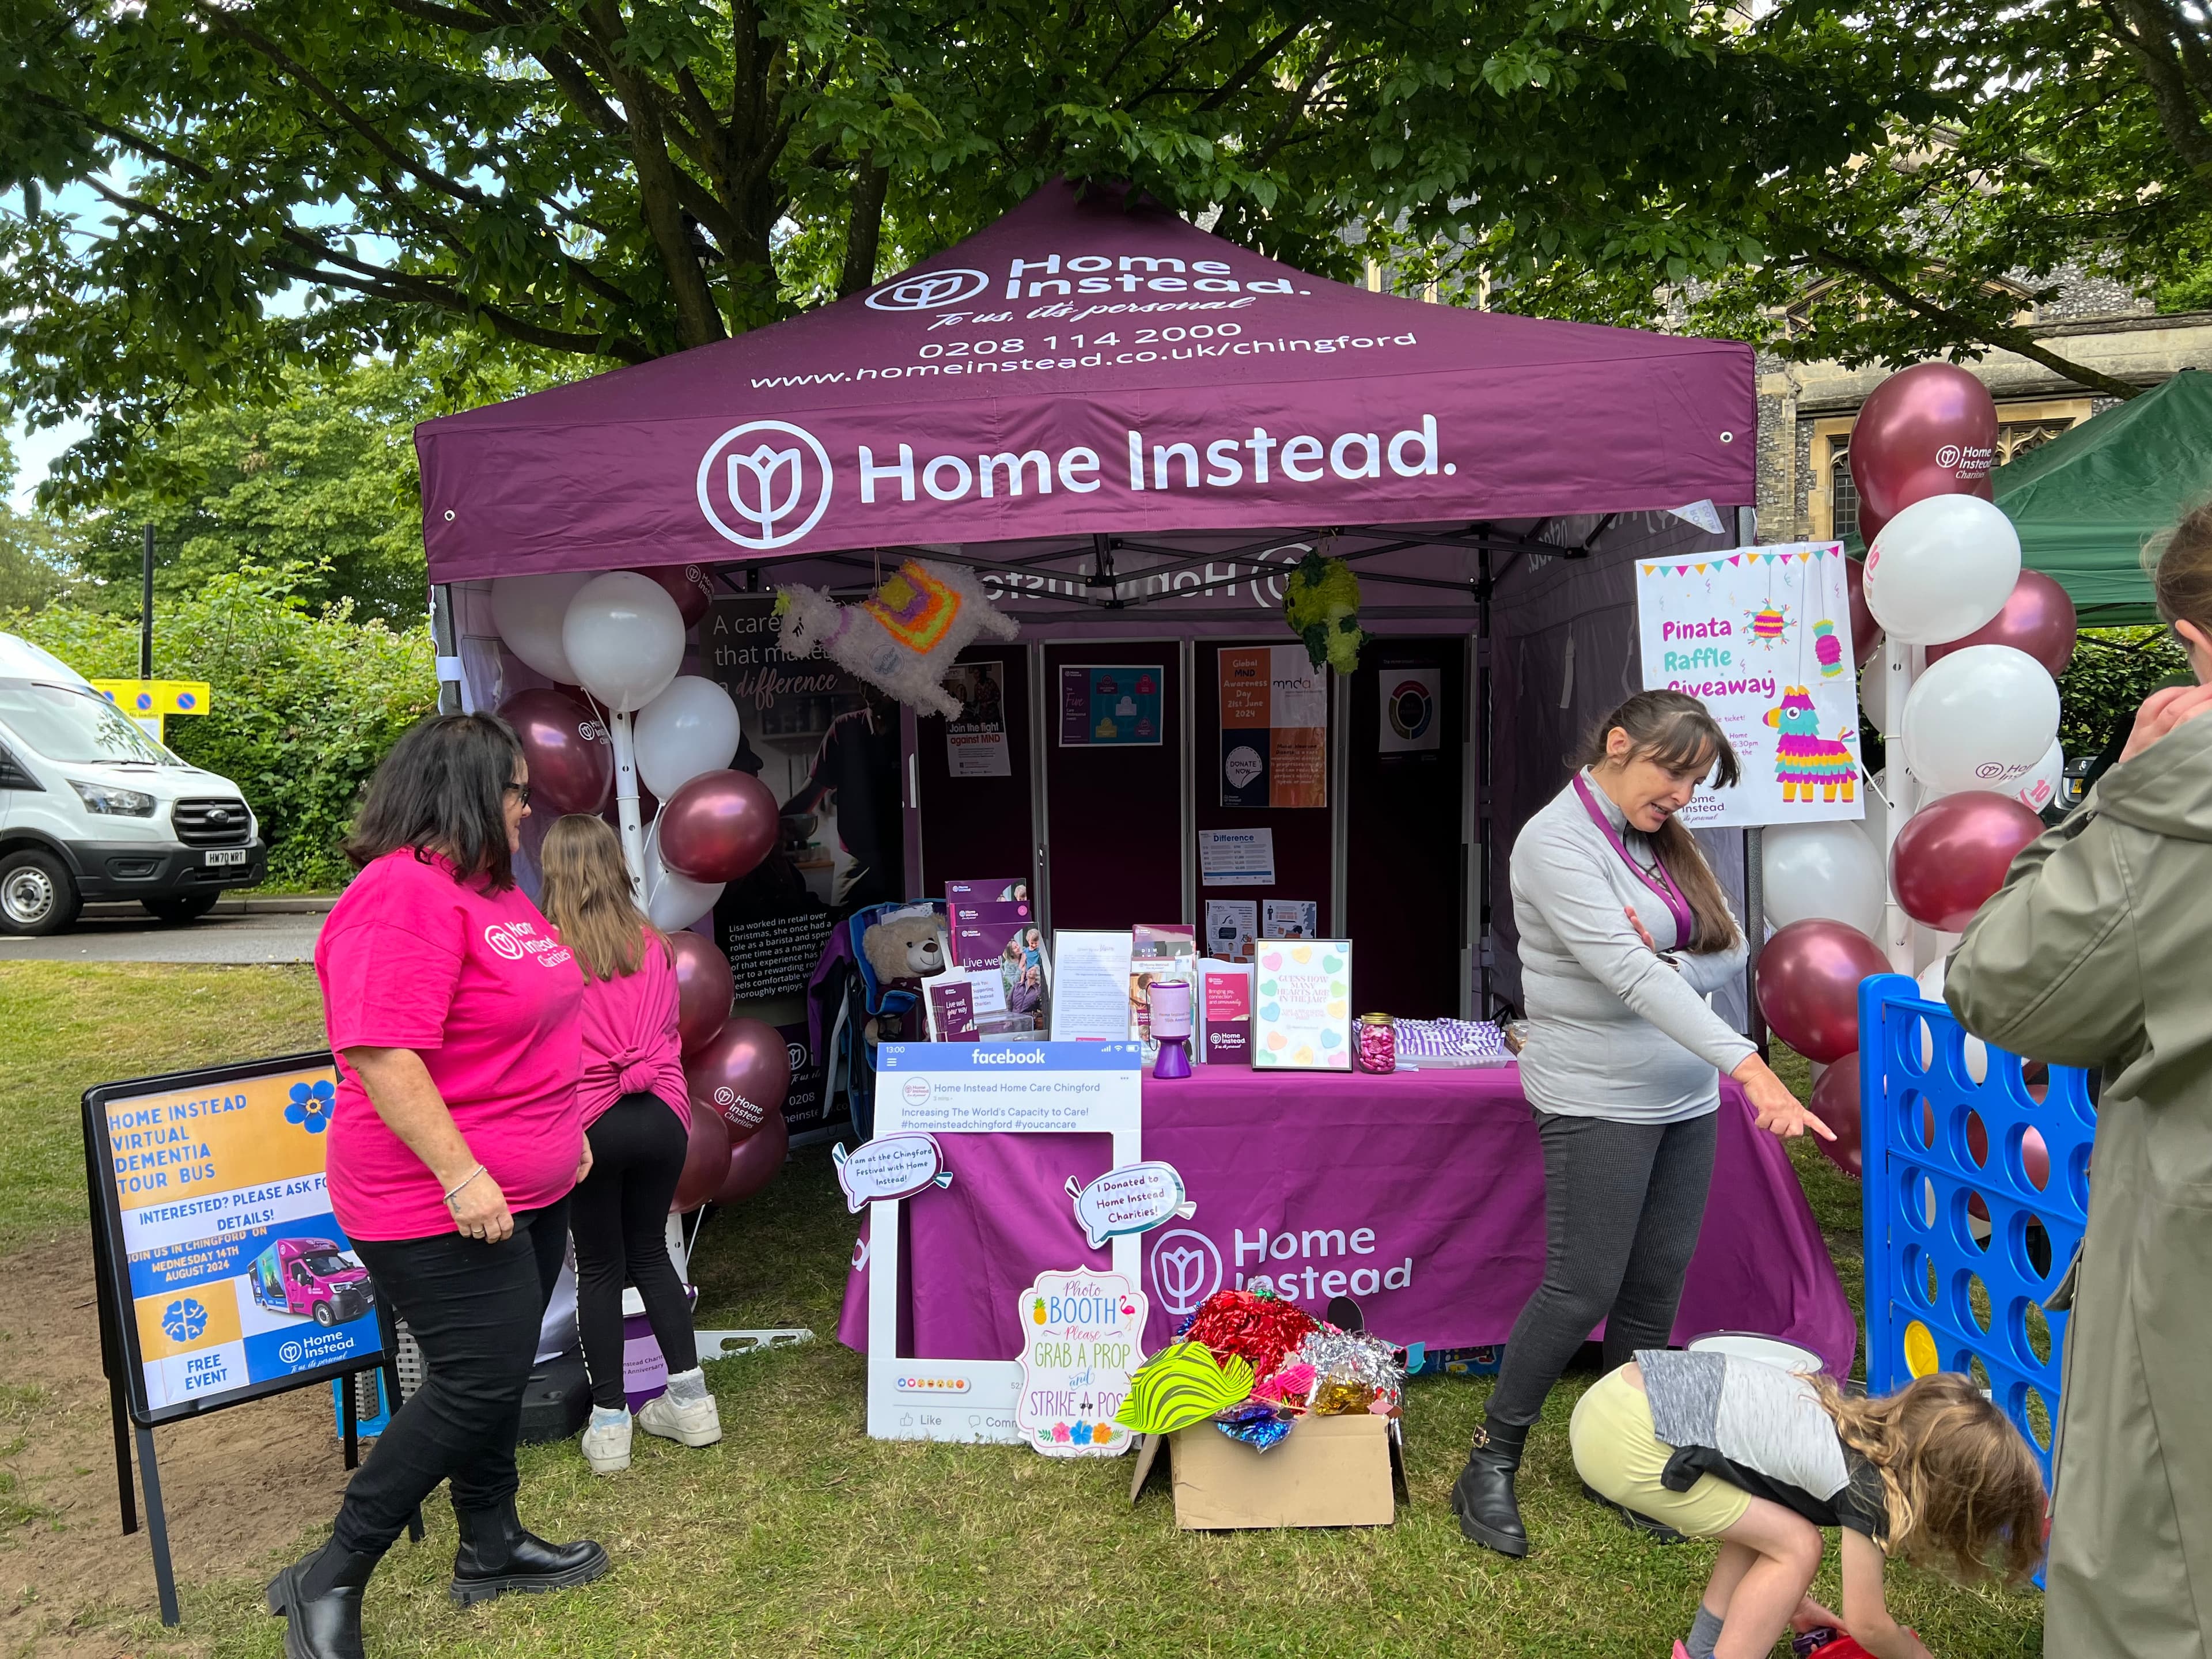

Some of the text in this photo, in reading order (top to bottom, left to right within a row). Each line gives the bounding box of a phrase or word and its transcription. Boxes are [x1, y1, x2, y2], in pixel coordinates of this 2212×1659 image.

[1009, 254, 1230, 278] Home
[1006, 272, 1311, 300] Instead.
[927, 312, 968, 331] To
[973, 308, 1013, 323] us,
[1070, 297, 1256, 323] personal
[919, 323, 1241, 357] 0208 114 2000
[749, 332, 1416, 388] www.homeinstead.co.uk/chingford
[858, 414, 1457, 503] Home Instead.
[1963, 446, 1991, 457] Home
[1959, 457, 1993, 469] Instead
[1956, 470, 1986, 479] Charities
[713, 615, 728, 635] A
[1663, 618, 1732, 642] Pinata
[714, 645, 759, 666] that
[1233, 659, 1257, 668] Global
[1664, 647, 1732, 672] Raffle
[1234, 669, 1255, 677] MND
[736, 666, 838, 710] difference
[1273, 677, 1310, 689] mnda
[1236, 690, 1251, 699] Day
[1228, 700, 1243, 708] 21st
[1235, 710, 1255, 718] 2024
[950, 722, 999, 733] Join the fight
[950, 734, 1000, 747] against MND
[1691, 813, 1718, 823] personal
[210, 853, 229, 863] HW70
[747, 919, 776, 930] worked
[788, 914, 808, 924] retail
[810, 912, 827, 921] over
[730, 931, 771, 942] Christmas,
[774, 927, 787, 935] she
[810, 921, 825, 930] had
[730, 942, 746, 952] role
[766, 935, 793, 946] barista
[795, 933, 809, 942] and
[730, 953, 752, 962] some
[754, 949, 772, 958] time
[792, 941, 818, 952] nanny.
[731, 951, 818, 971] of that experience has
[764, 963, 804, 975] rewarding
[963, 958, 982, 968] Live
[753, 972, 800, 987] comfortable
[946, 1001, 955, 1009] Live
[957, 1007, 968, 1016] way
[972, 1048, 1045, 1064] facebook
[934, 1082, 1100, 1094] Home Instead Home Care Chingford
[735, 1095, 763, 1114] Home
[789, 1092, 815, 1106] 0208
[109, 1095, 247, 1130] HOME INSTEAD
[724, 1112, 753, 1128] Charities
[729, 1103, 764, 1124] Instead
[902, 1107, 1089, 1118] Increasing The World's Capacity to Care!
[901, 1120, 1076, 1130] #homeinsteadchingford #youcancare
[112, 1126, 190, 1152] VIRTUAL
[115, 1143, 211, 1173] DEMENTIA
[878, 1153, 891, 1161] the
[893, 1148, 933, 1161] Chingford
[856, 1160, 929, 1177] Festival with Home
[118, 1164, 215, 1194] TOUR BUS
[876, 1174, 908, 1186] Instead!
[1104, 1175, 1159, 1191] Donated to
[139, 1181, 312, 1225] INTERESTED? PLEASE ASK
[1096, 1188, 1165, 1209] Home Instead
[218, 1210, 274, 1230] DETAILS!
[1108, 1205, 1158, 1224] Charities!
[128, 1226, 267, 1263] JOIN US IN CHINGFORD ON
[1234, 1227, 1376, 1267] Home
[152, 1245, 239, 1273] WEDNESDAY 14TH
[166, 1261, 229, 1282] AUGUST 2024
[1063, 1280, 1103, 1297] Photo
[1051, 1297, 1116, 1324] BOOTH
[304, 1331, 343, 1348] Home
[1065, 1325, 1101, 1342] Please
[187, 1354, 221, 1373] FREE
[317, 1351, 348, 1368] personal
[1035, 1342, 1130, 1369] GRAB A PROP
[627, 1363, 664, 1374] Anniversary
[185, 1369, 227, 1390] EVENT
[1069, 1365, 1095, 1391] and
[1031, 1391, 1091, 1417] STRIKE A
[921, 1414, 942, 1426] Like
